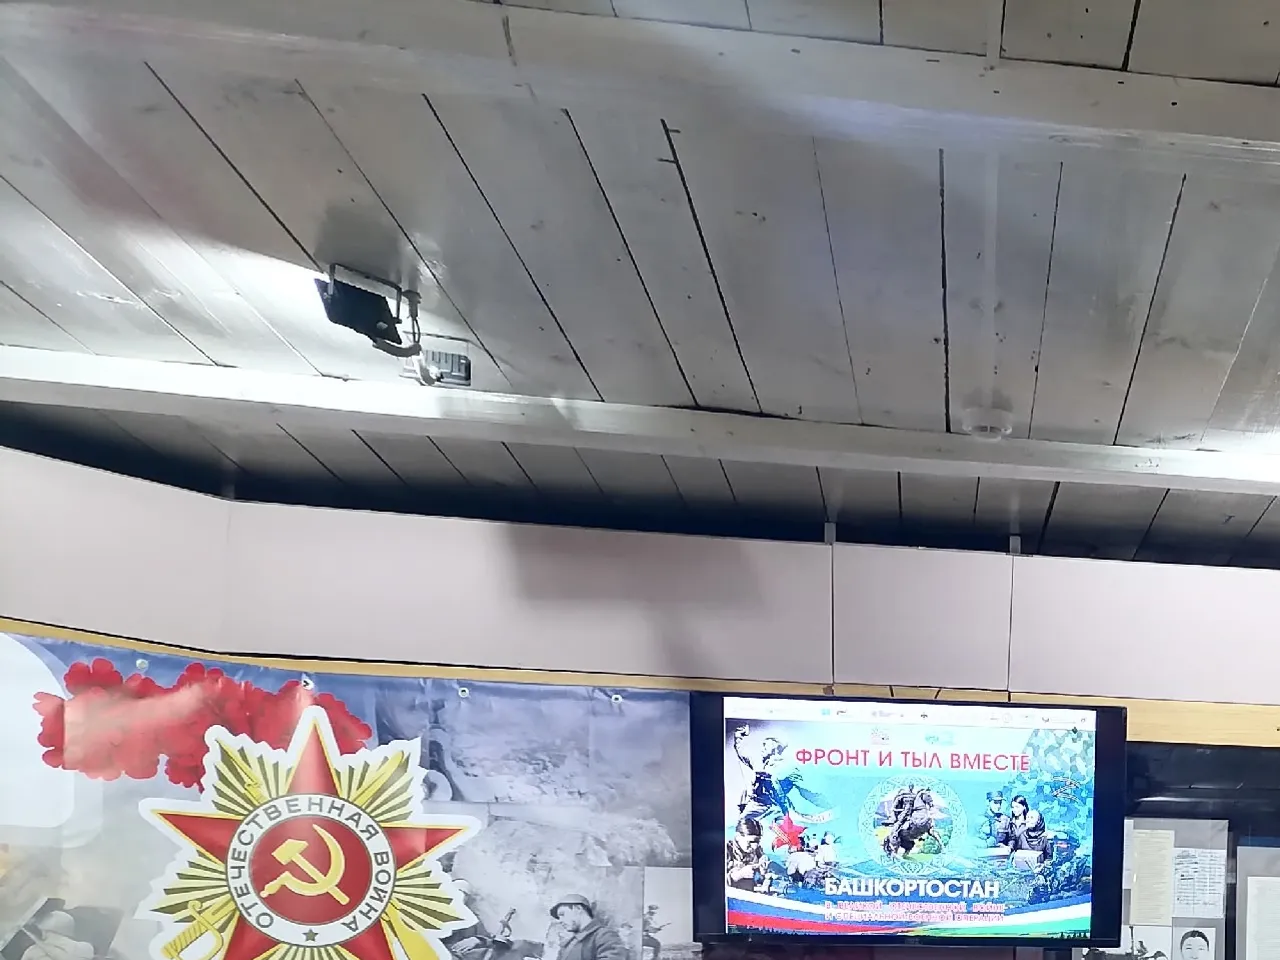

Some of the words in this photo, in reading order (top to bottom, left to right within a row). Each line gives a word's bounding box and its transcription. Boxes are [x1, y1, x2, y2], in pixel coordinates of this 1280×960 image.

[795, 748, 870, 768] ФРОНТ
[877, 751, 892, 768] И
[901, 751, 943, 770] ТЫЛ
[950, 753, 1030, 772] ВМЕСТЕ
[229, 796, 380, 930] ОТЕЧЕСТВЕННАЯ
[342, 850, 392, 934] ВОЙНА
[824, 877, 999, 898] БАШКОРТОСТАН
